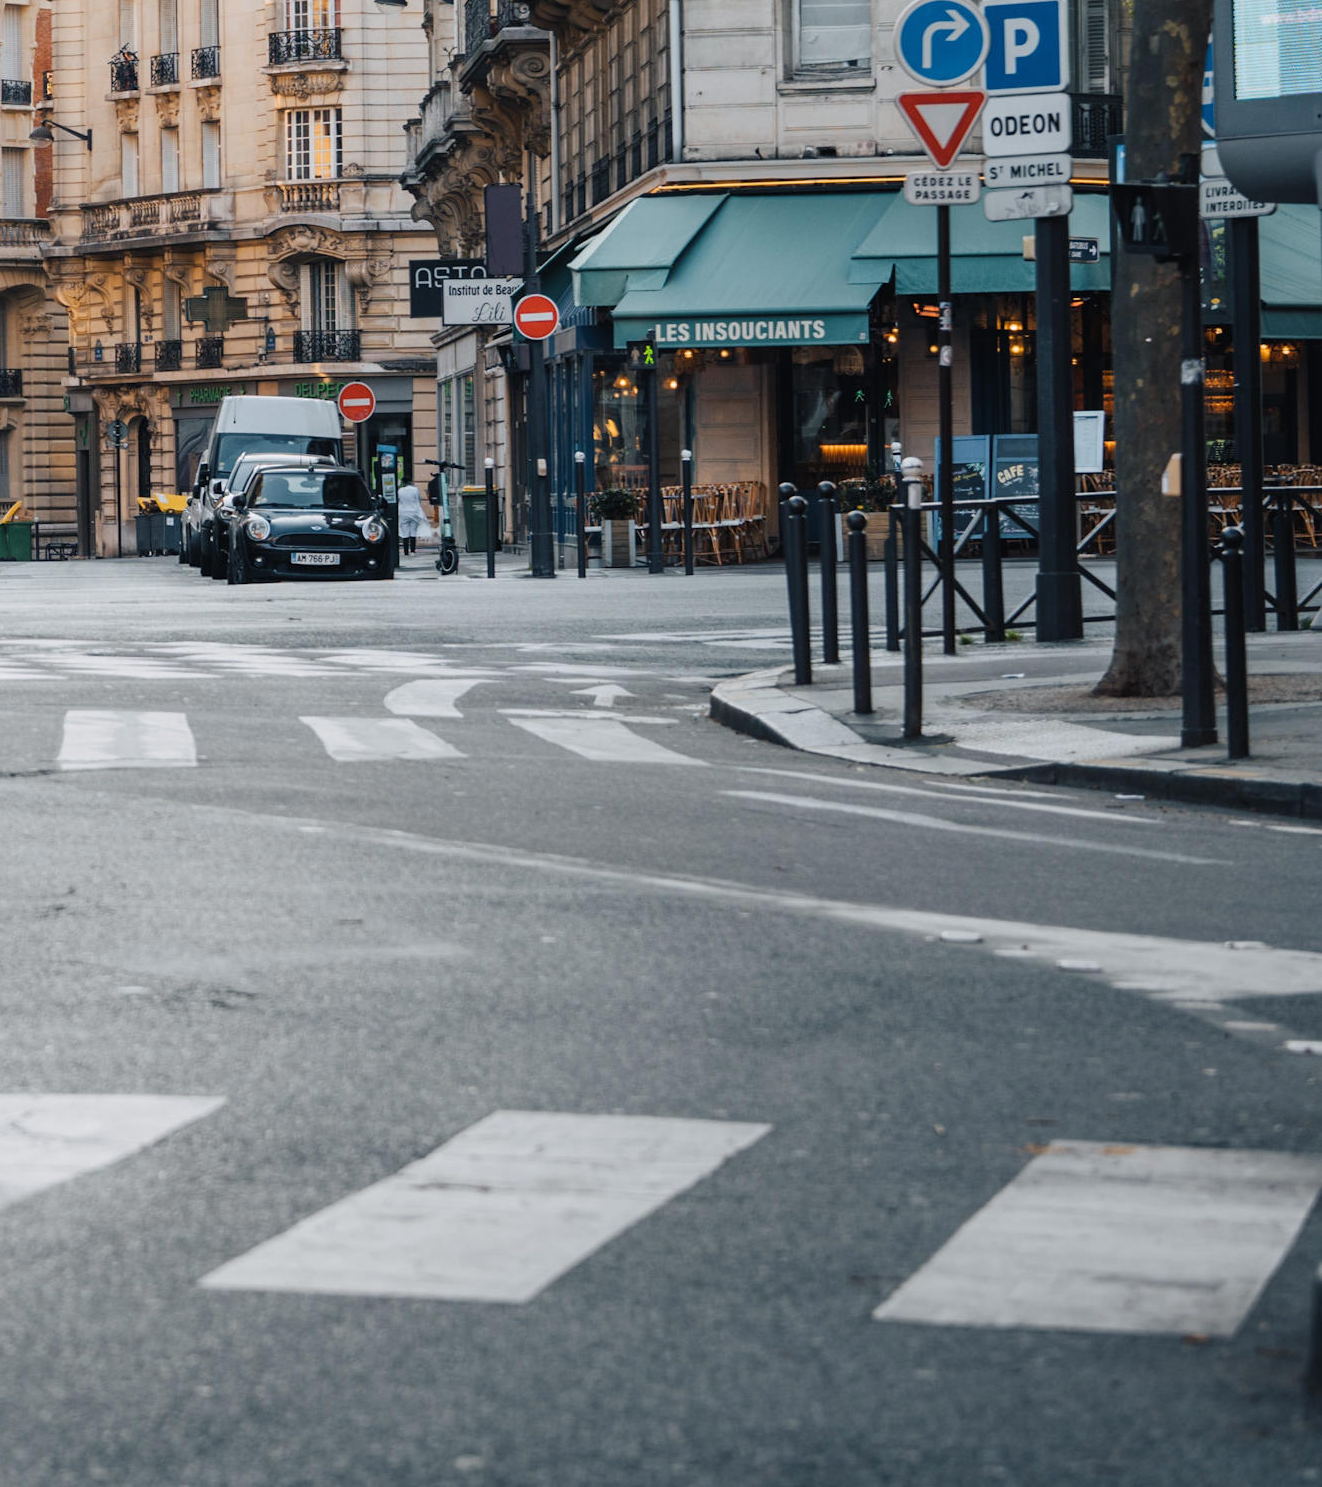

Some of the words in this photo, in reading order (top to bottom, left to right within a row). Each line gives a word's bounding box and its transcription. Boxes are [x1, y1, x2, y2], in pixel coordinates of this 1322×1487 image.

[1003, 17, 1040, 75] P
[990, 113, 1060, 137] ODEON
[1010, 162, 1064, 179] MICHEL
[913, 177, 953, 187] CÉDEZ
[958, 176, 972, 186] LE
[915, 190, 970, 200] PASSAGE
[448, 285, 480, 296] Institut
[482, 284, 493, 296] de
[655, 322, 690, 342] LES
[695, 320, 825, 341] INSOUCIANTS
